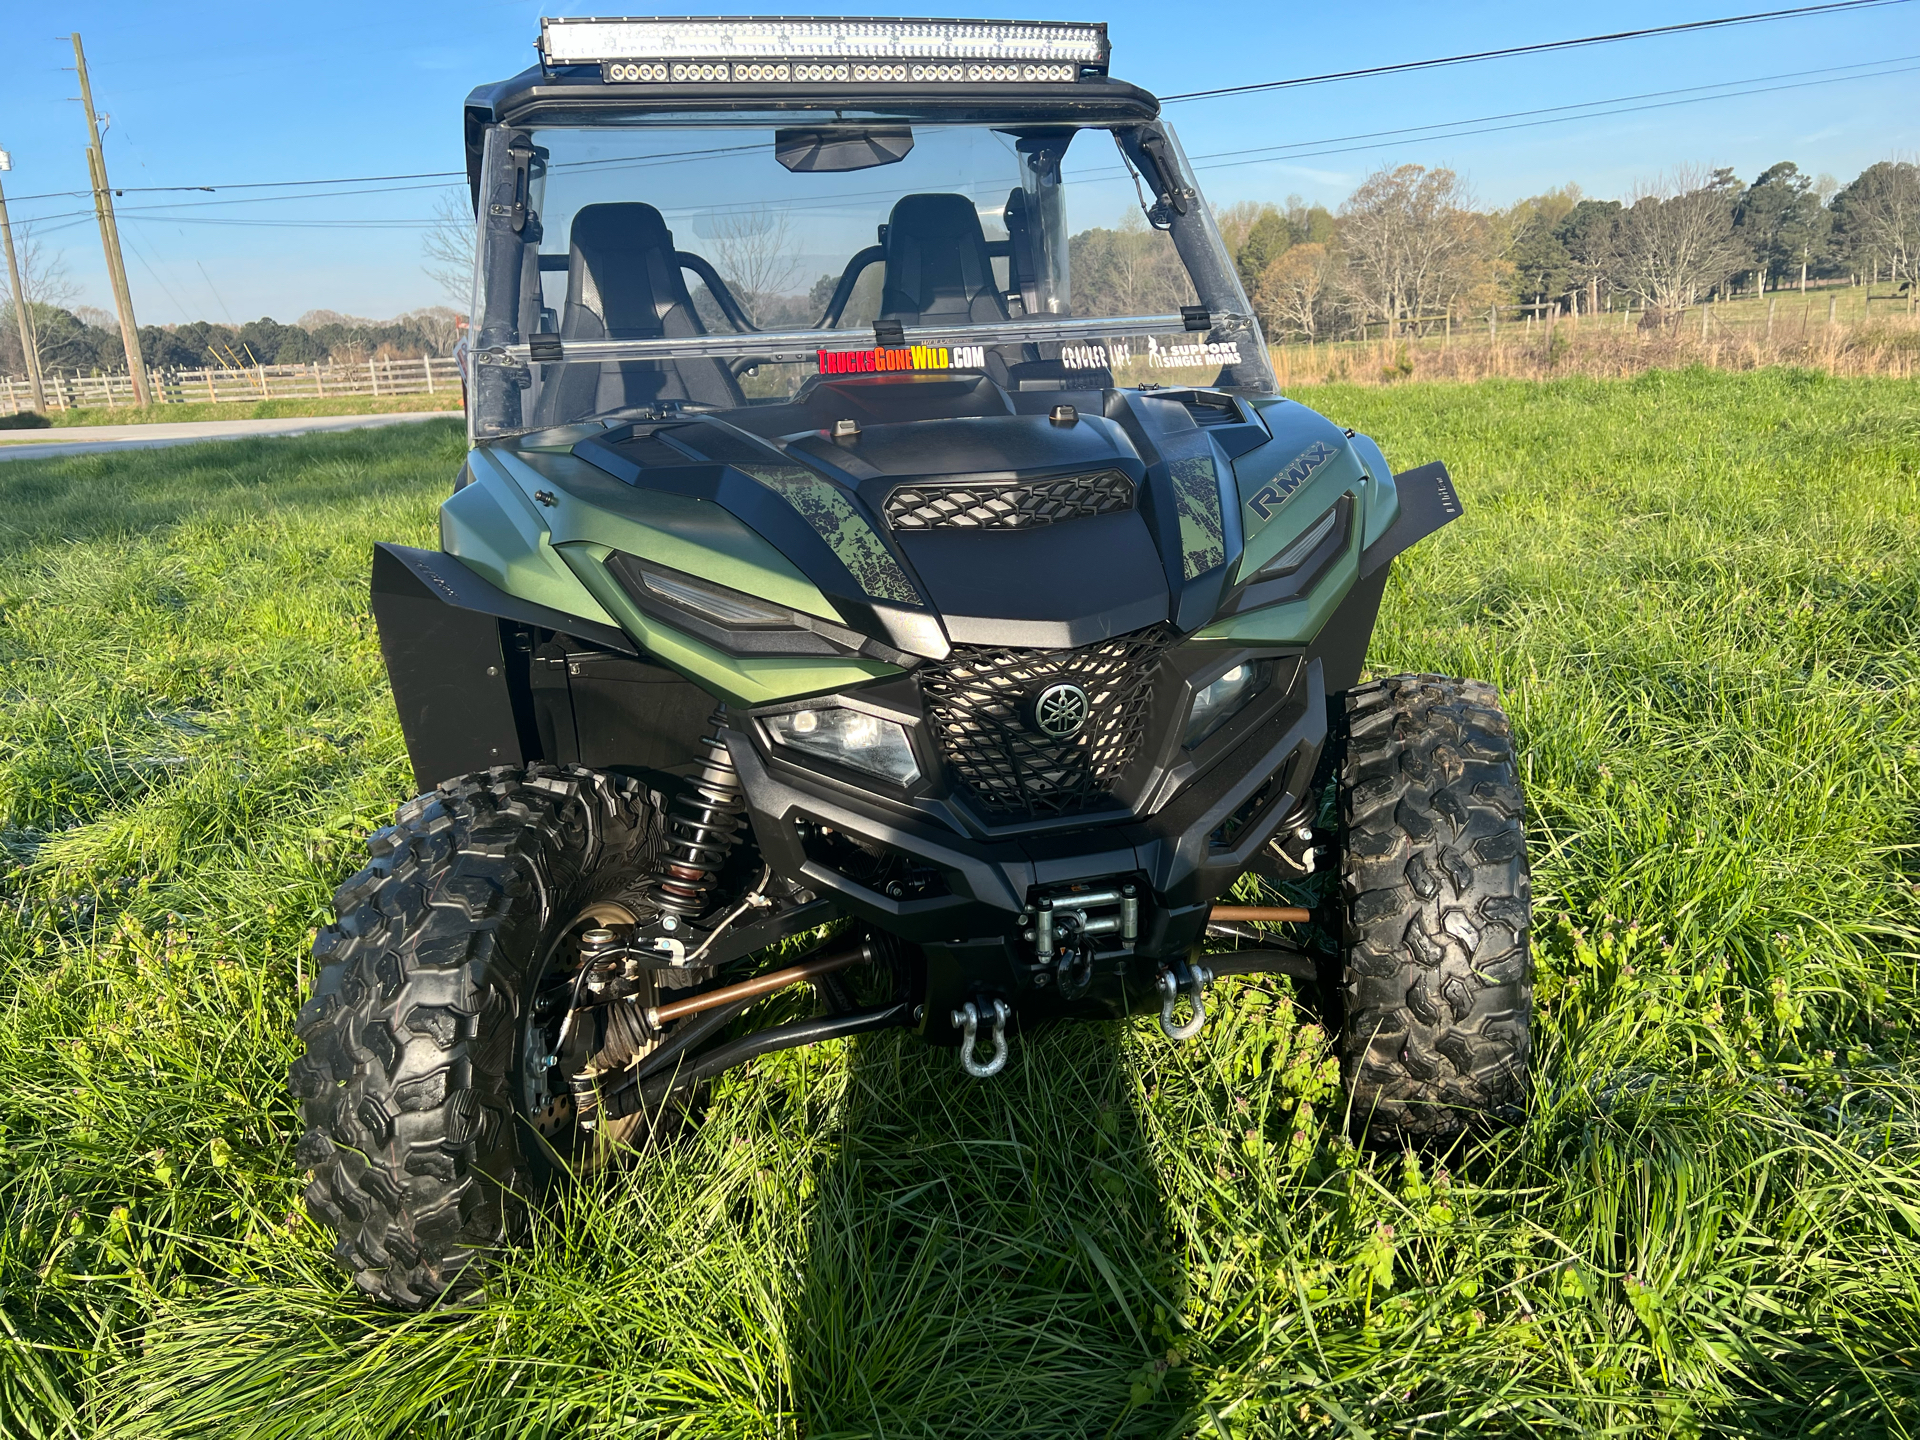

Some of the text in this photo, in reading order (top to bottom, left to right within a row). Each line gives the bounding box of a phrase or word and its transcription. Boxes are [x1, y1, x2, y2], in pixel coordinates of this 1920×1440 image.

[1061, 345, 1108, 370] CRACKER
[1161, 341, 1238, 357] I SUPPORT
[1162, 352, 1243, 368] SINGLE MOMS
[1247, 441, 1338, 522] RMAX
